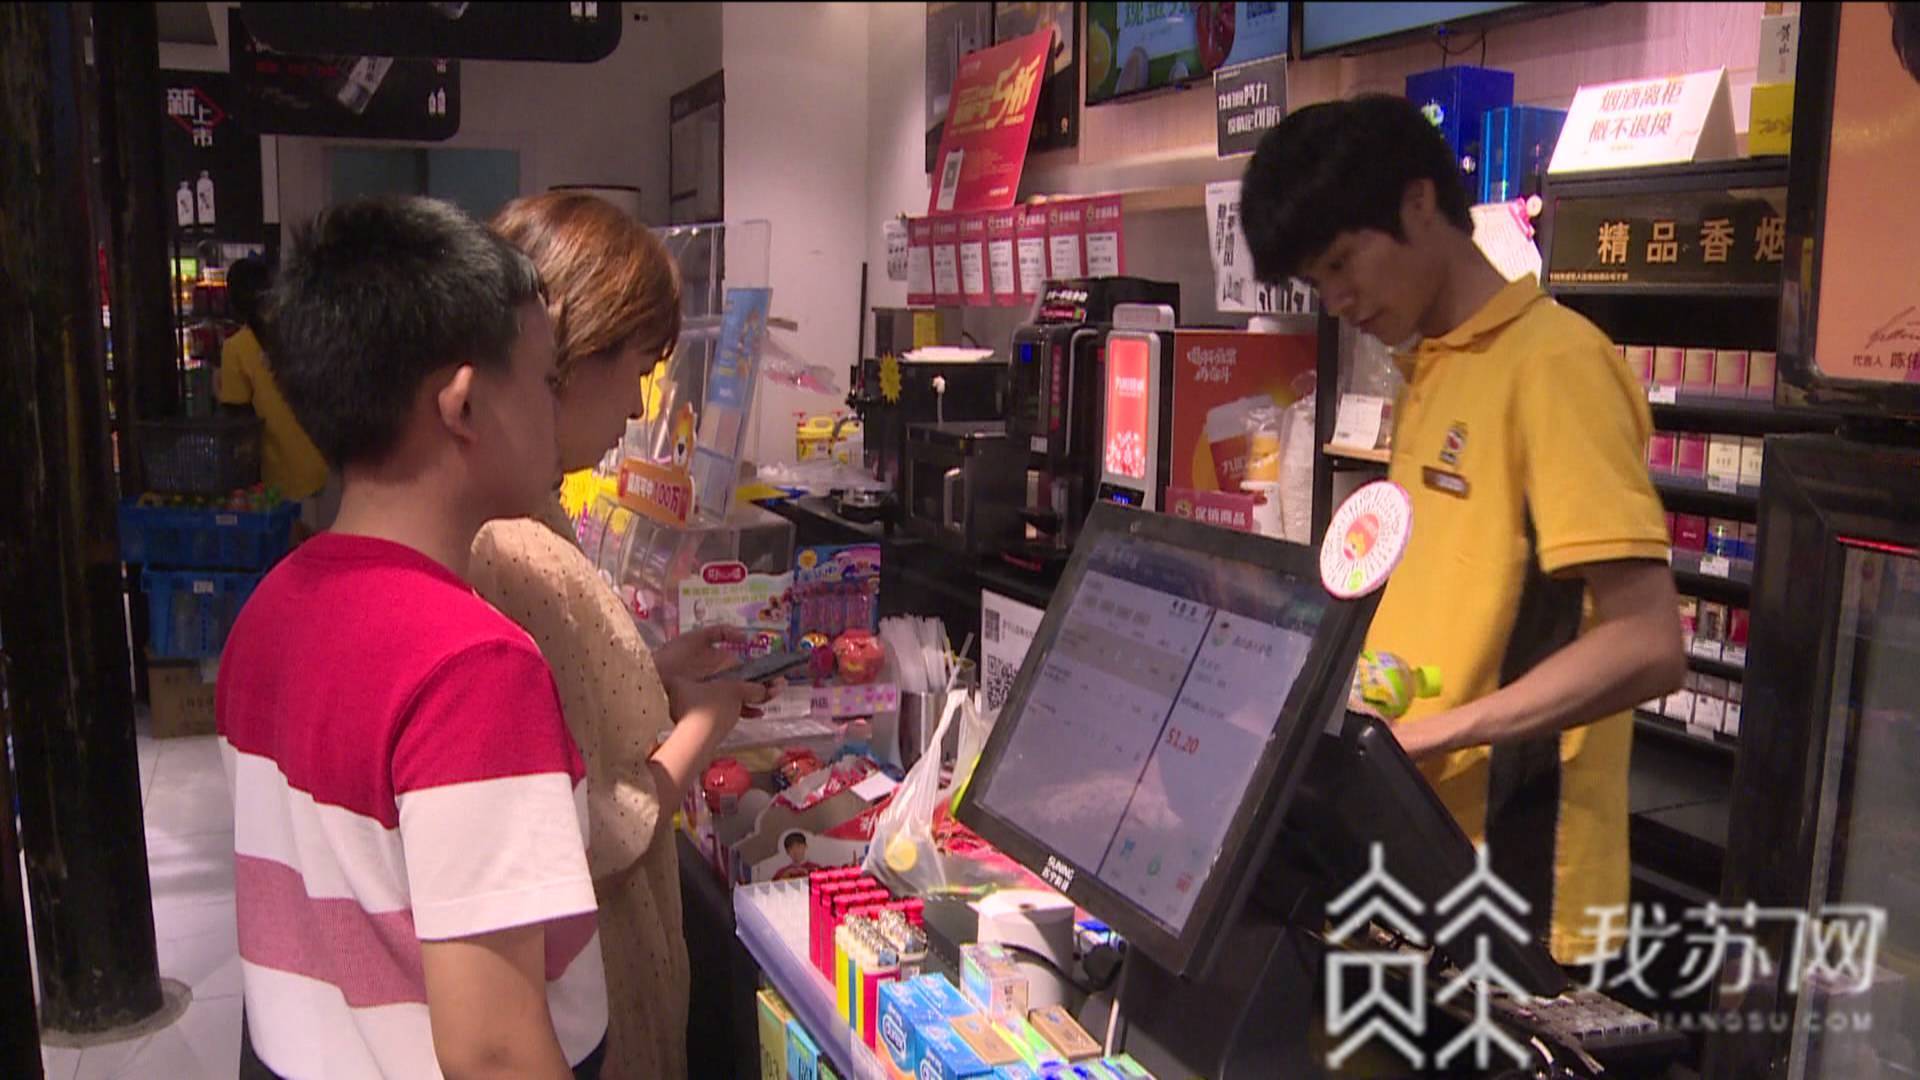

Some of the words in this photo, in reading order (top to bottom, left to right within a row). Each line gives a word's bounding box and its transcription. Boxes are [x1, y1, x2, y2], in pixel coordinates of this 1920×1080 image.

[1600, 81, 1684, 112] 烟酒离柜
[1589, 110, 1673, 142] 概不退换
[1597, 217, 1785, 264] 精品香烟
[1853, 354, 1883, 368] 代言人
[1047, 855, 1075, 881] SUNING
